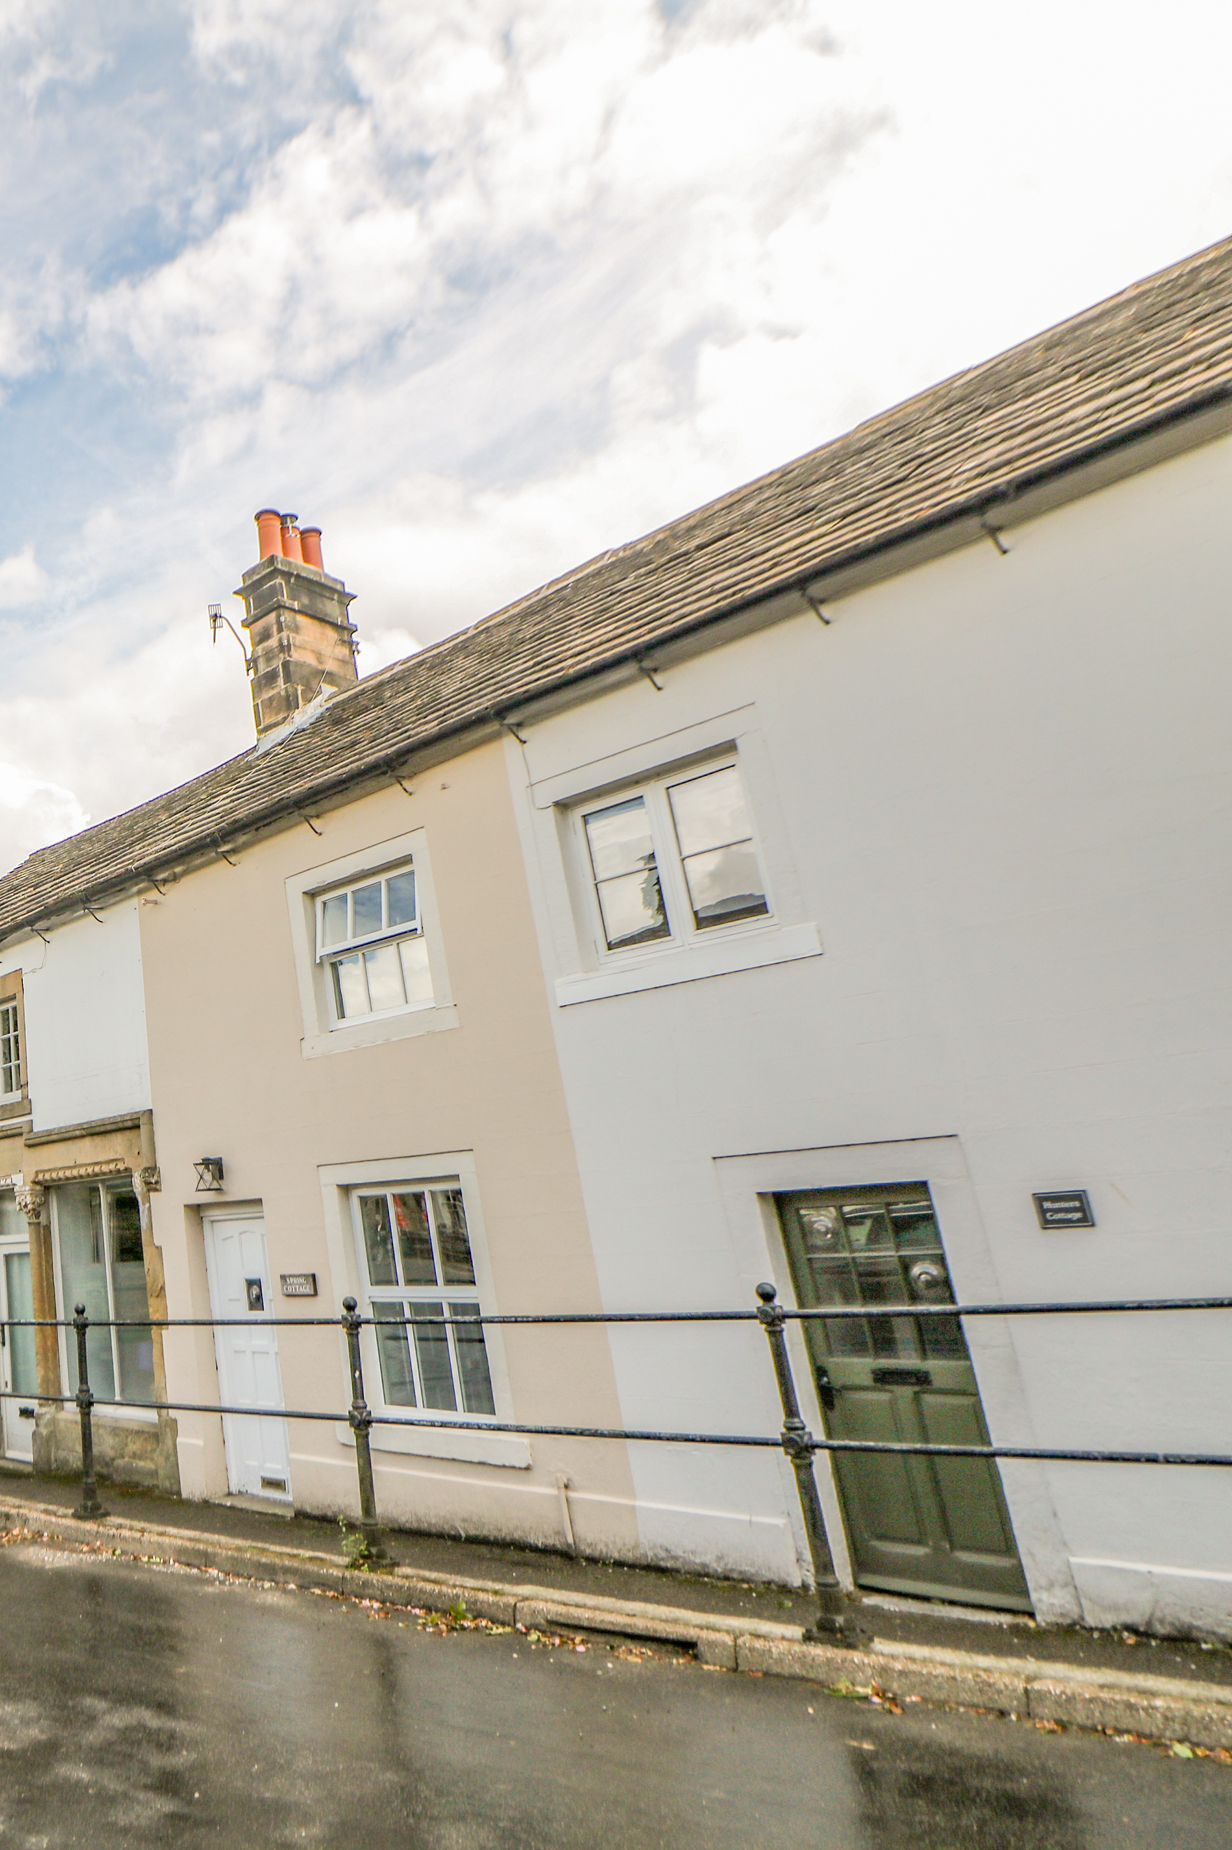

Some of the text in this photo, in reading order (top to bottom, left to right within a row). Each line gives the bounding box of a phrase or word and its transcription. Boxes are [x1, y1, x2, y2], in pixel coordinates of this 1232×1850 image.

[1046, 1212, 1084, 1220] Cottage
[286, 1276, 307, 1284] SPRING
[283, 1285, 310, 1293] COTTAGE
